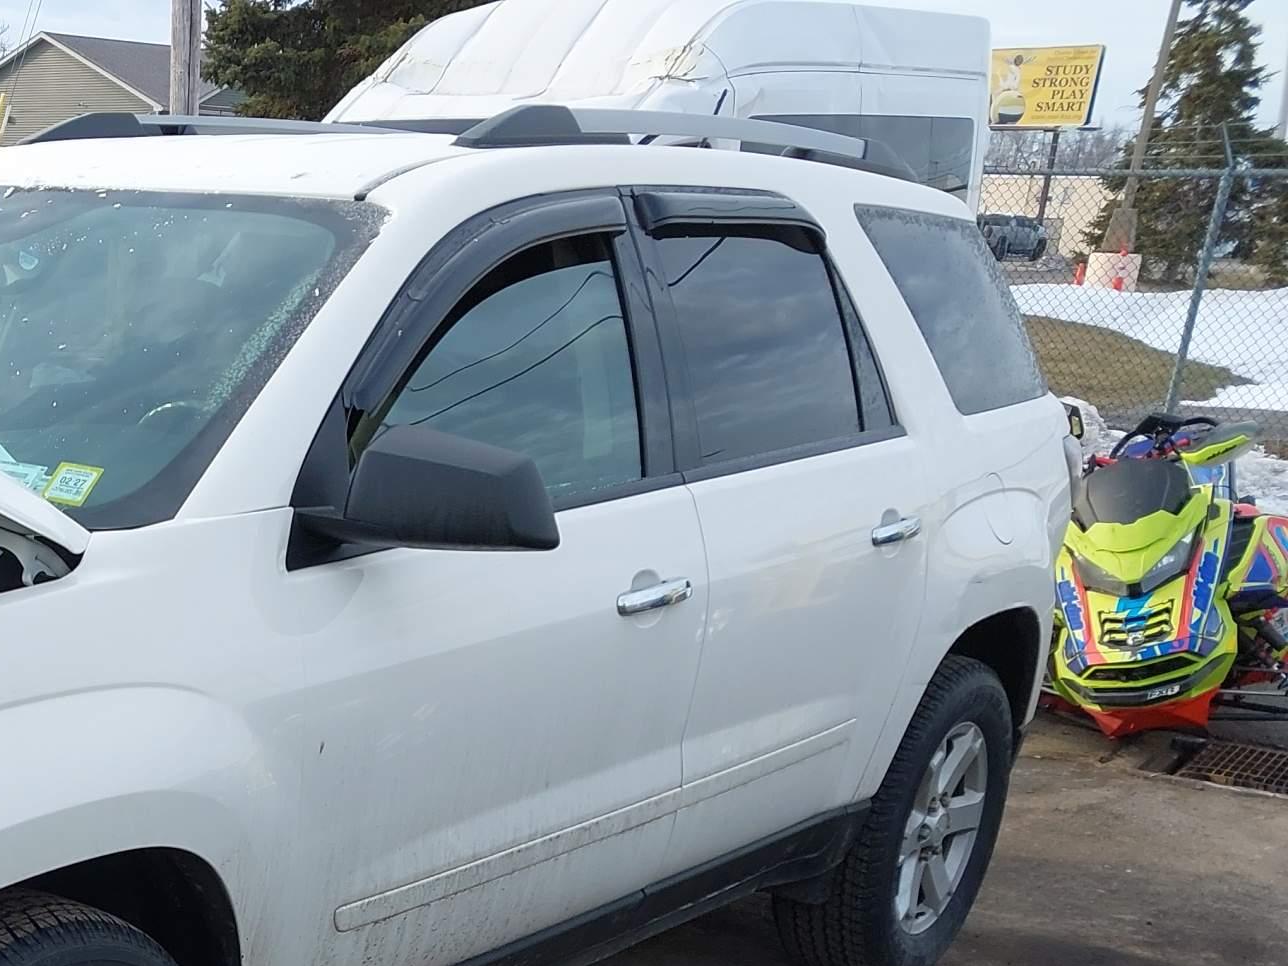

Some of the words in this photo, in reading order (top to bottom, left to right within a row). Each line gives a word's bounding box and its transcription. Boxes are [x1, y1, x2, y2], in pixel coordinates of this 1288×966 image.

[1046, 65, 1093, 76] STUDY
[1032, 76, 1090, 88] STRONG
[1051, 89, 1088, 100] PLAY
[1035, 101, 1085, 112] SMART
[59, 476, 72, 486] 02
[73, 478, 88, 488] 27
